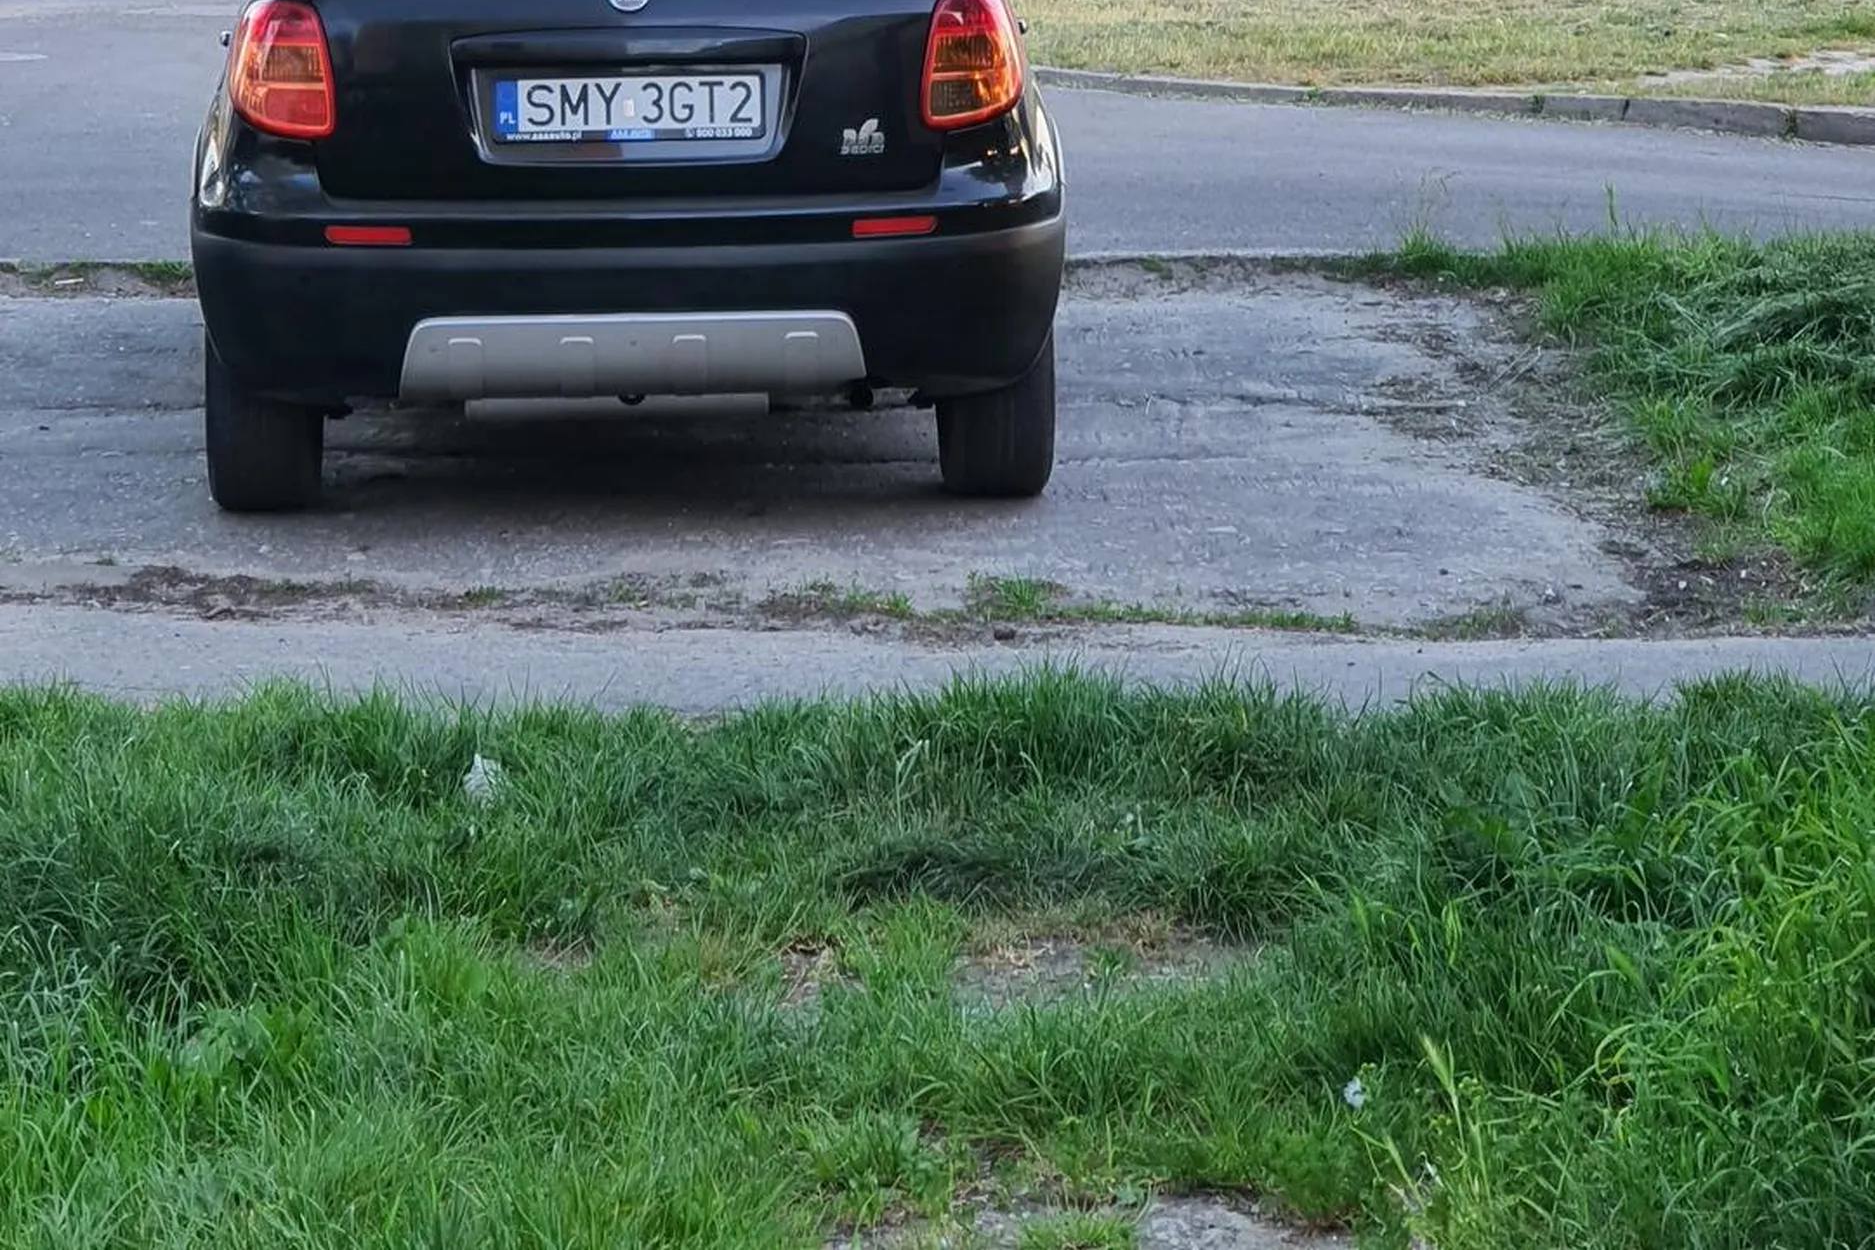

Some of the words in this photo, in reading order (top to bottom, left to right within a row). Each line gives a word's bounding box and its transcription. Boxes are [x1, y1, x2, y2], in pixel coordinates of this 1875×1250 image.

[500, 111, 516, 125] PL
[526, 82, 622, 127] SMY
[641, 80, 753, 125] 3GT2
